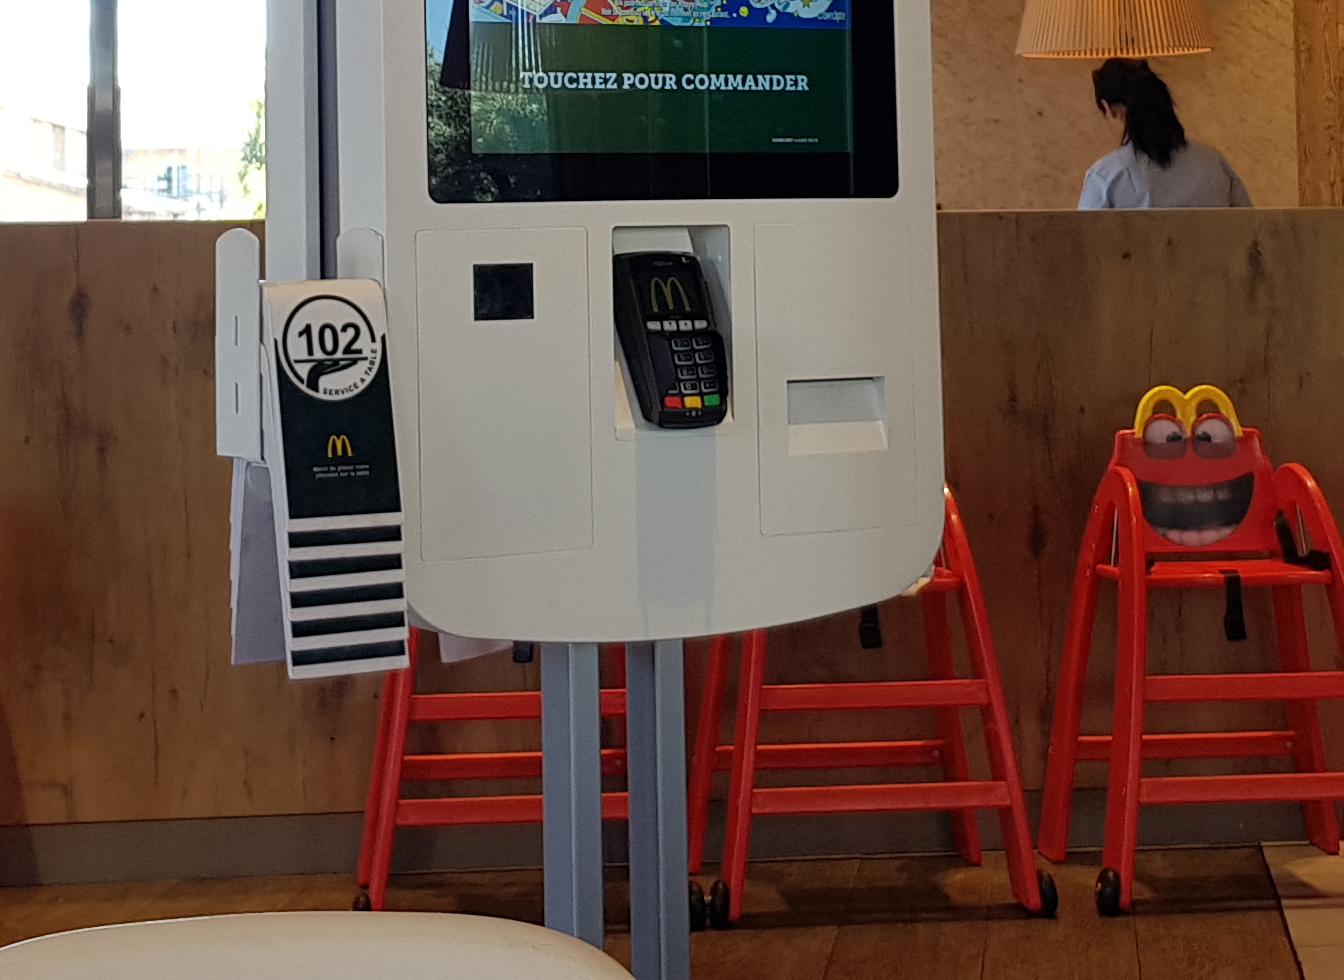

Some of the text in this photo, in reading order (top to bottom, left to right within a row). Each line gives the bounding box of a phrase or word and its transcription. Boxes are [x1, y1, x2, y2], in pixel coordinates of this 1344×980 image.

[520, 71, 810, 92] TOUCHEZ POUR COMMANDER
[297, 322, 364, 358] 102
[322, 381, 361, 397] SERVICE
[363, 347, 378, 377] TABLE
